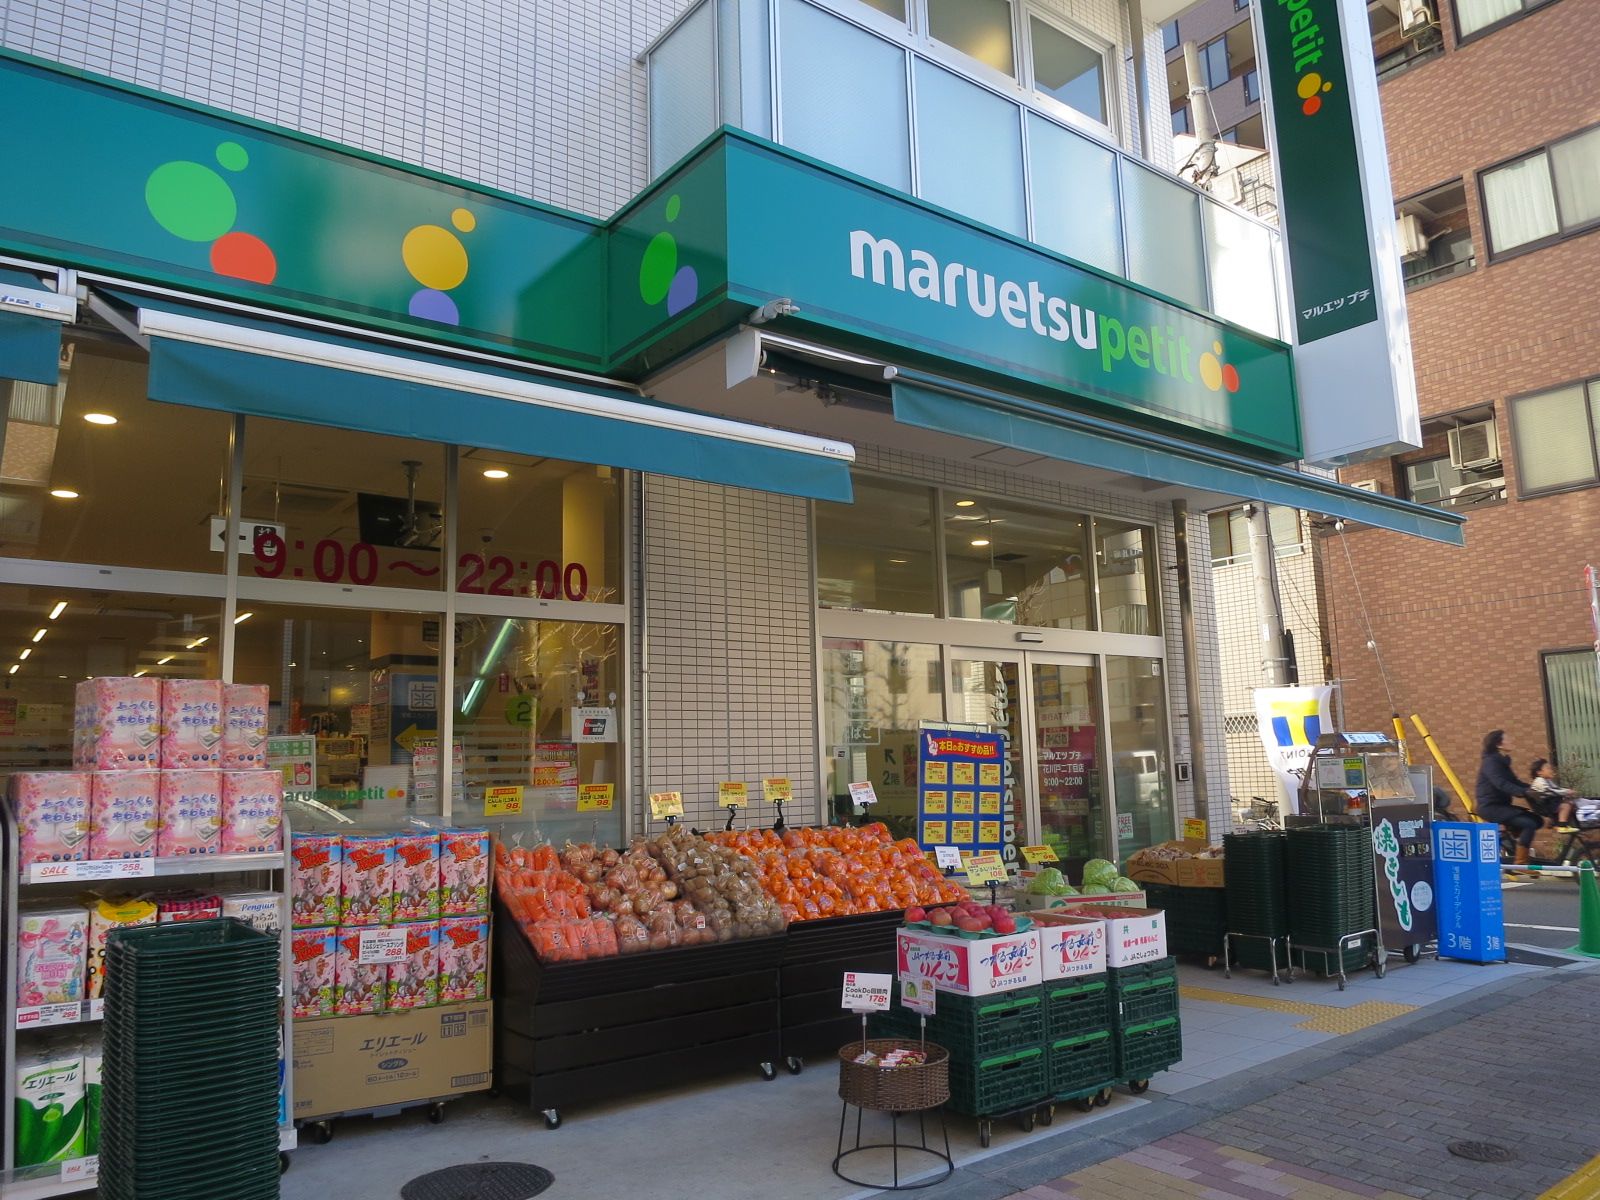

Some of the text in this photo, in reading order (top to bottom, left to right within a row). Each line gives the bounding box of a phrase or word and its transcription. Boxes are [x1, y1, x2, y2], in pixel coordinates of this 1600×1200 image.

[849, 230, 1194, 384] maruetsu petit
[1302, 297, 1345, 320] マルエツ
[1118, 815, 1131, 825] FREE
[41, 866, 69, 875] SALE
[241, 902, 276, 912] Penguin
[919, 961, 959, 981] りんご
[359, 1032, 429, 1052] エリエール
[25, 1072, 77, 1090] エリエール
